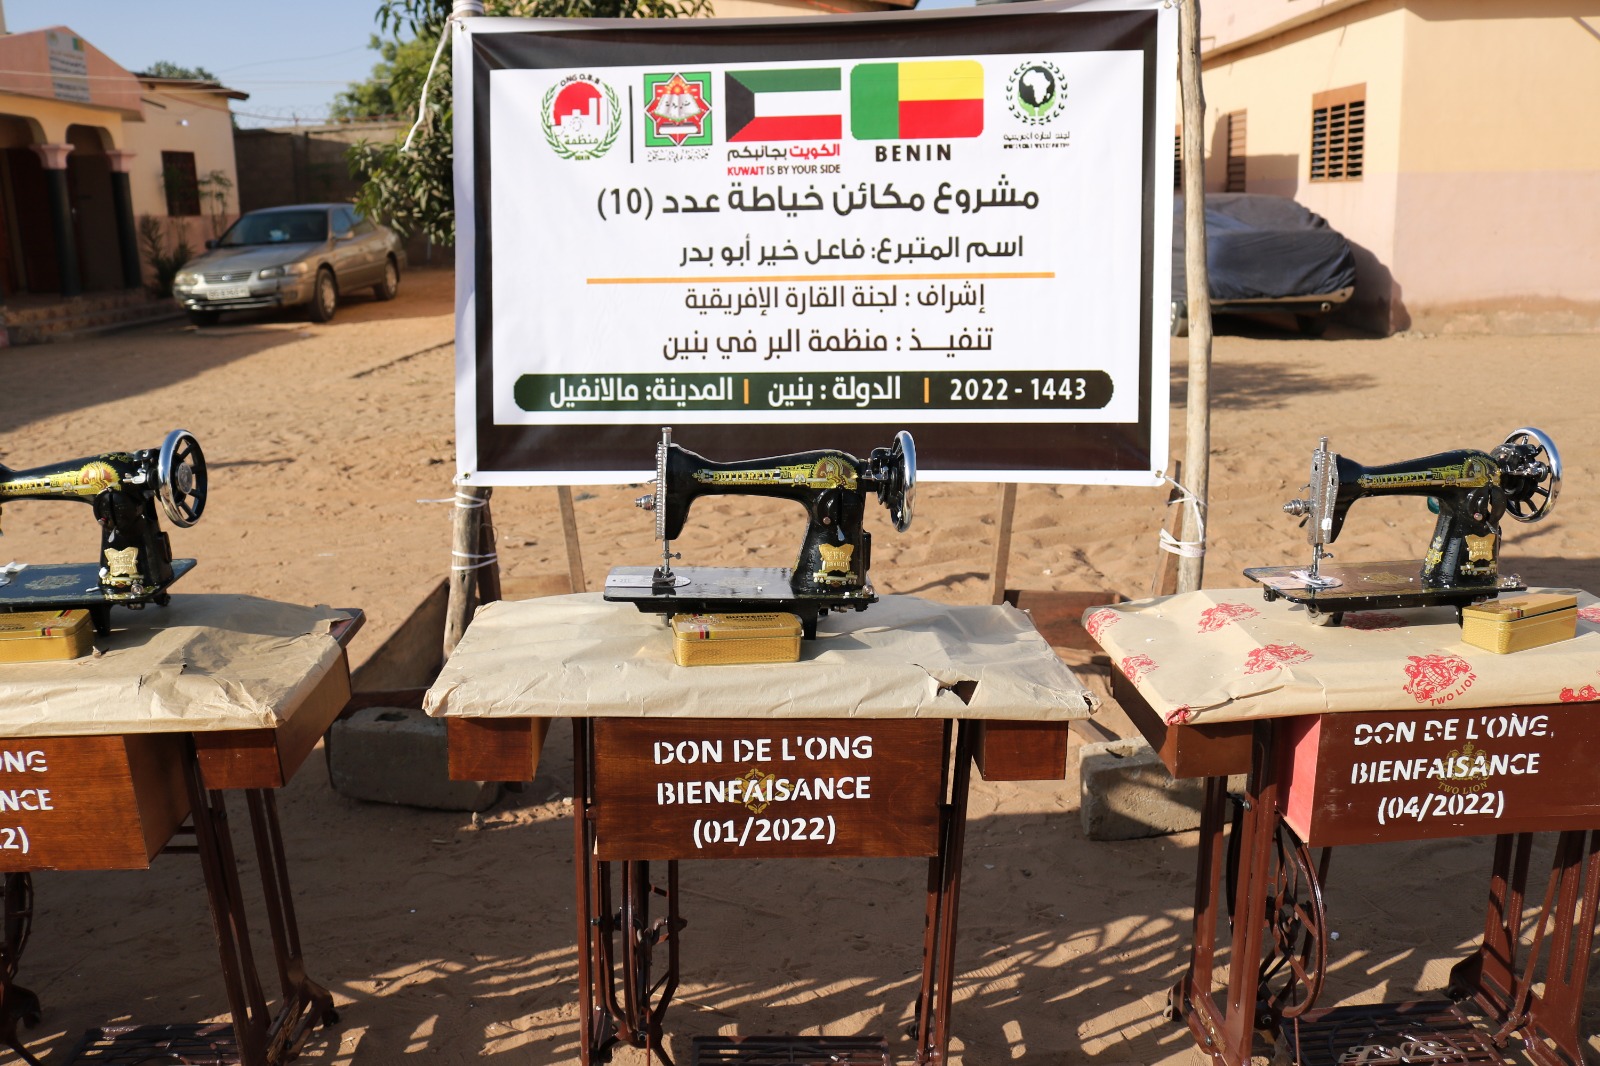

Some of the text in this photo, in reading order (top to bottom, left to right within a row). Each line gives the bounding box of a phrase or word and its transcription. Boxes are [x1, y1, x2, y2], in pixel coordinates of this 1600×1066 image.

[727, 145, 787, 161] بجانبكم
[789, 143, 840, 160] الكويت
[875, 144, 952, 163] BENIN
[727, 164, 841, 176] KUWAIT IS BY YOUR SIDE
[662, 194, 721, 214] عدد
[727, 182, 824, 218] خياطة
[832, 182, 926, 217] مكائن
[934, 173, 1040, 215] مشروع
[679, 246, 714, 267] بدر
[720, 233, 751, 267] أبو
[757, 239, 799, 266] خير
[804, 237, 866, 265] فاعل
[967, 235, 1024, 263] اسم
[684, 287, 779, 316] الإفريقية
[785, 286, 845, 316] القارة
[851, 285, 897, 313] لجنة
[916, 280, 986, 314] إشراف
[662, 330, 708, 361] بنين
[716, 330, 757, 360] في
[763, 329, 801, 361] البر
[808, 328, 888, 352] منظمة
[549, 377, 639, 408] مالانفيل
[767, 377, 814, 407] بنين
[832, 376, 901, 407] الدولة
[950, 378, 1009, 401] 2022
[1030, 377, 1087, 401] 1443
[712, 471, 775, 481] BUTTERFLY
[1371, 472, 1428, 485] BUTTERFLY
[1430, 672, 1477, 707] TWO LION
[1353, 721, 1417, 746] DON
[1423, 718, 1460, 742] DE
[0, 750, 48, 773] NG
[654, 735, 873, 765] DON DE L'ONG
[1351, 753, 1540, 785] BIENFAISANCE
[657, 776, 871, 805] BIENFAISANCE
[1438, 781, 1488, 795] TWO LION
[1377, 790, 1504, 826] (04/2022)
[0, 826, 29, 854] 2)
[693, 815, 836, 849] (01/2022)
